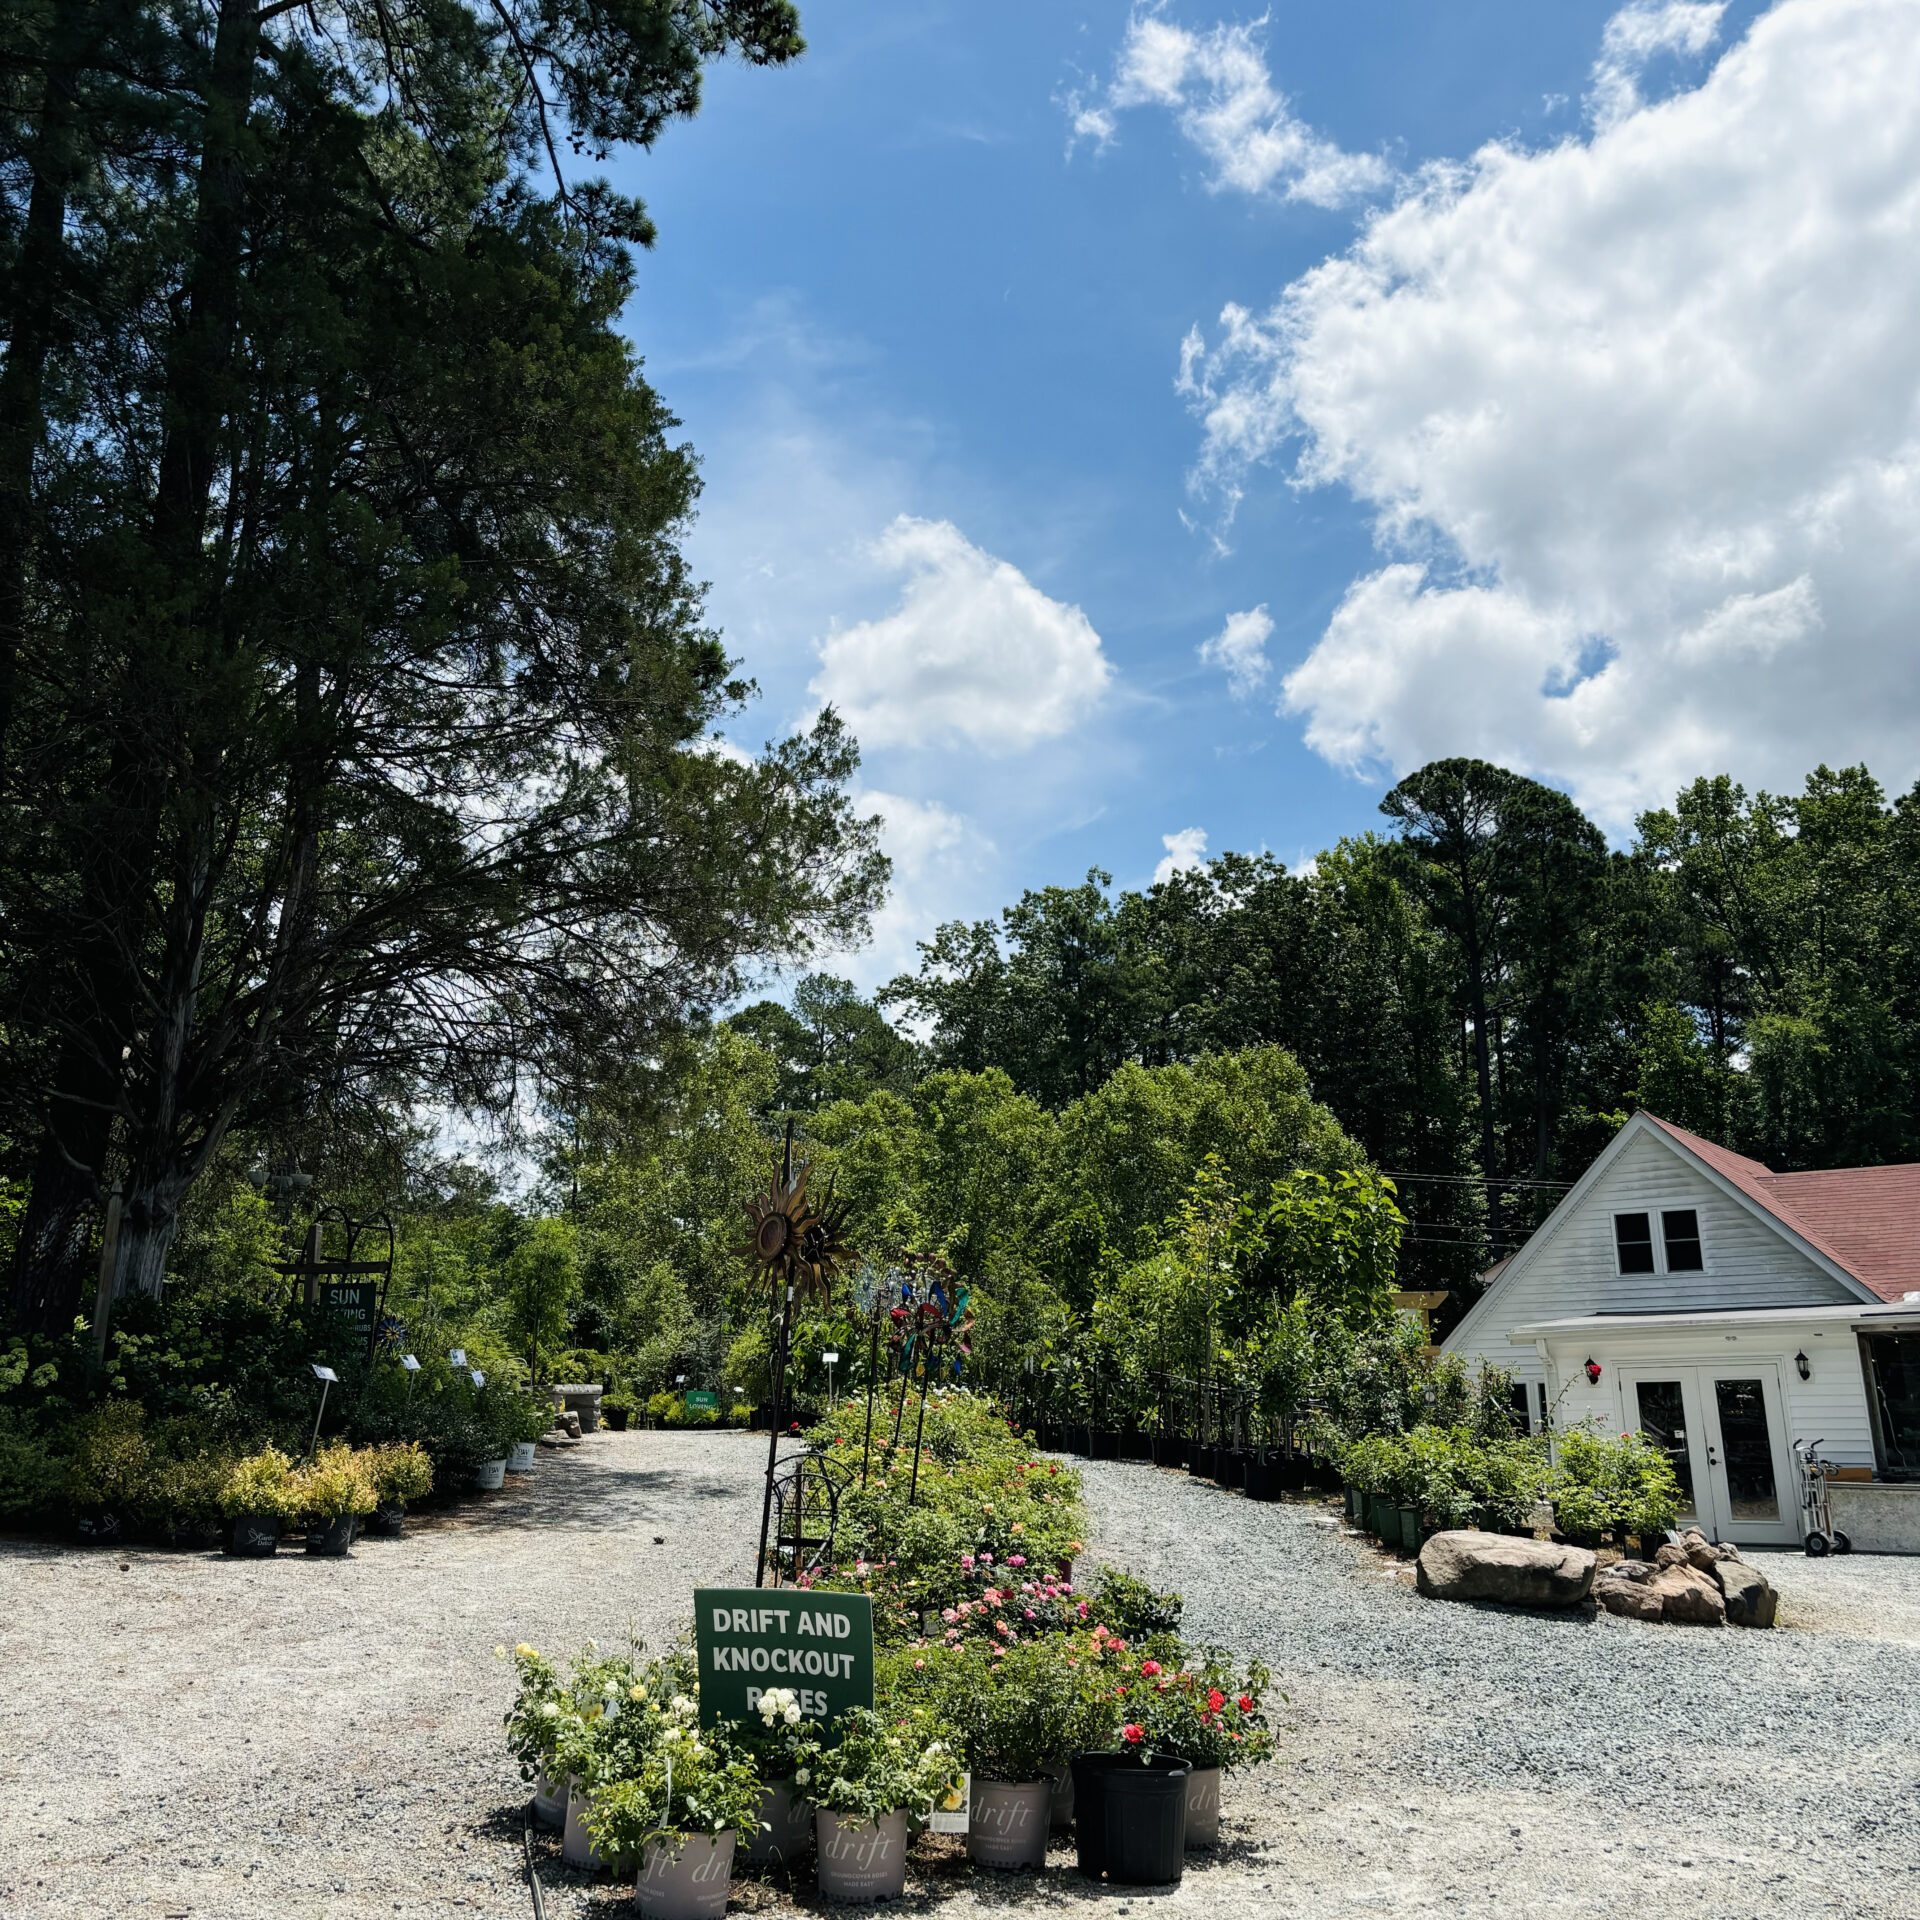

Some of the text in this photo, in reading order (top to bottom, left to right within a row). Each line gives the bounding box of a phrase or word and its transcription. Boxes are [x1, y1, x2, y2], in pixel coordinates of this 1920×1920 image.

[329, 1288, 360, 1304] SUN
[713, 1609, 850, 1639] DRIFT AND
[713, 1647, 855, 1680] KNOCKOUT
[746, 1687, 828, 1716] RES
[970, 1796, 1033, 1835] drift
[825, 1831, 897, 1871] drift
